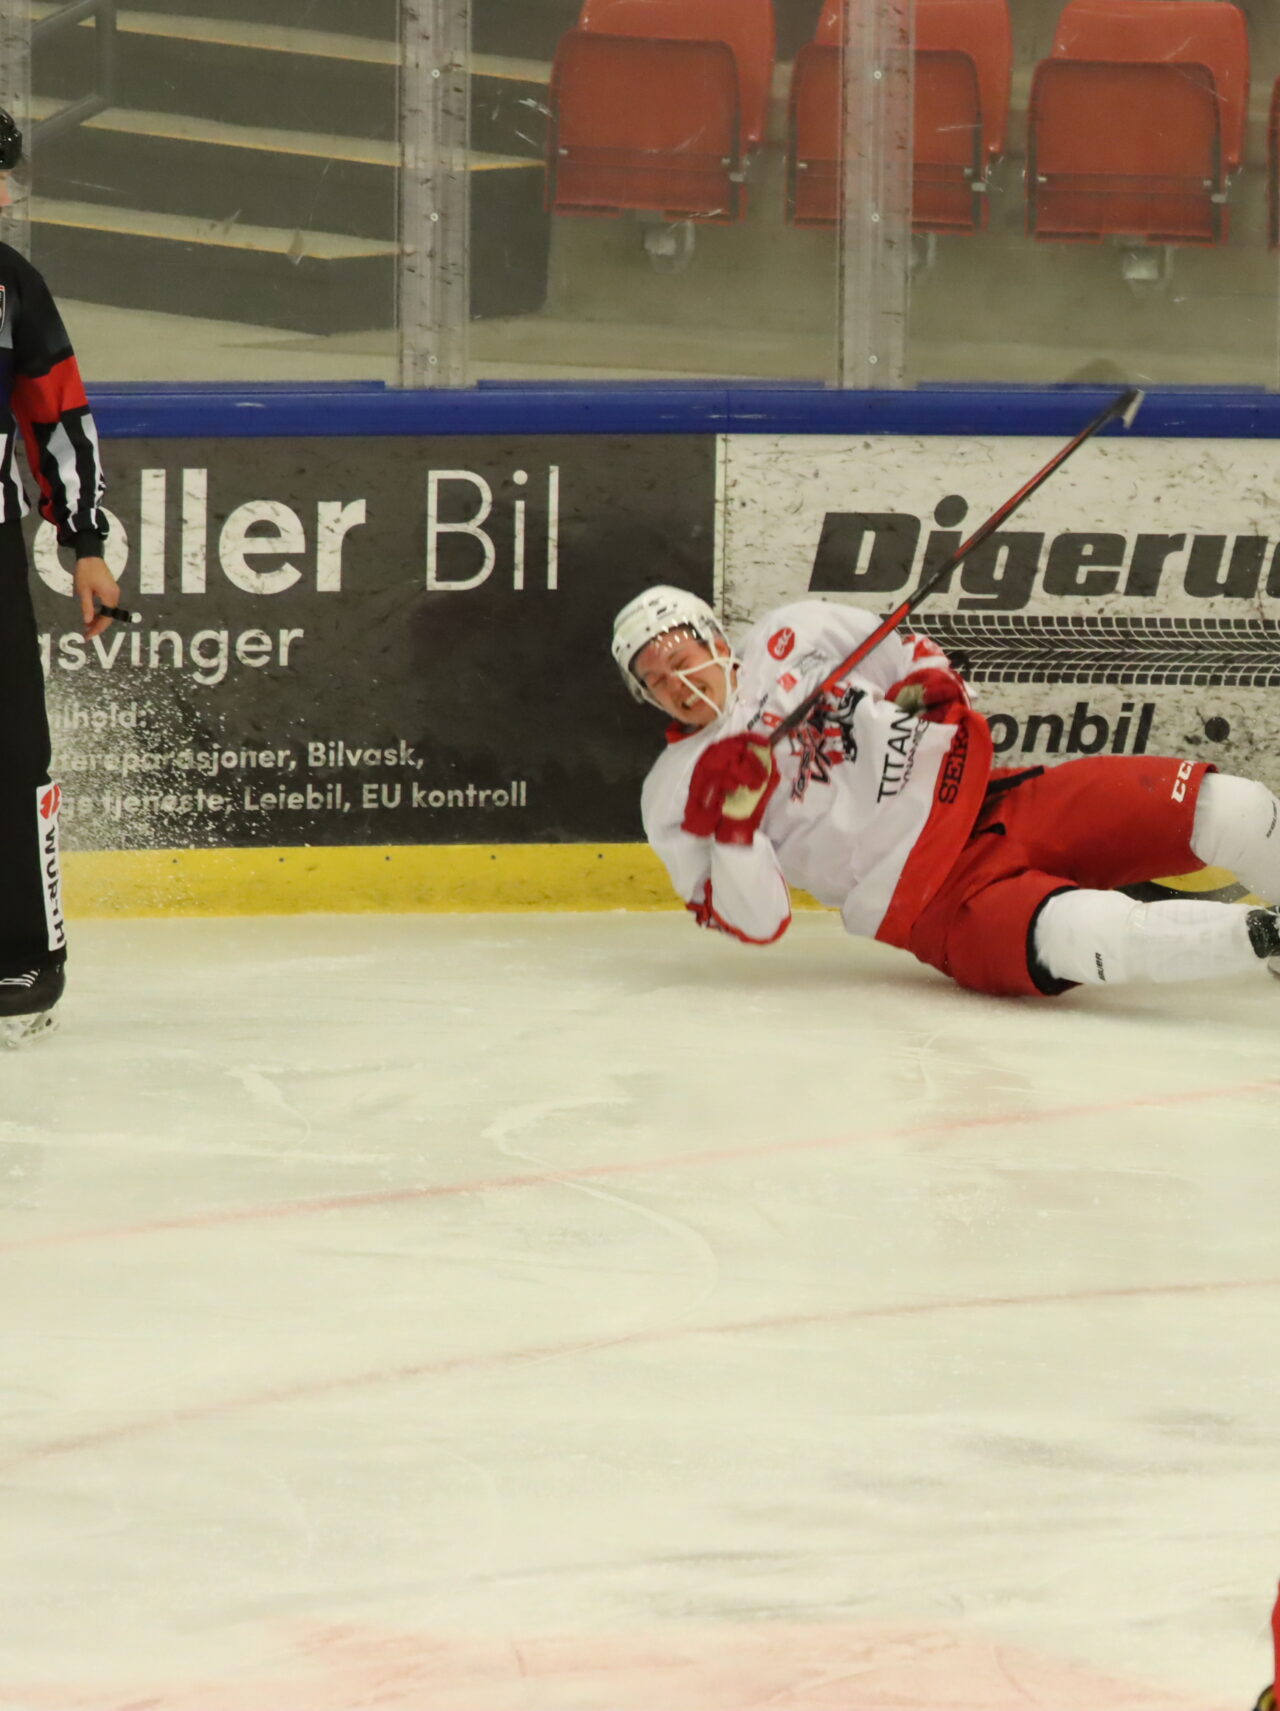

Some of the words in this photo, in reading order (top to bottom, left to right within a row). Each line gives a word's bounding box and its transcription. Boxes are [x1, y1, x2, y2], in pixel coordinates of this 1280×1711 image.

[426, 466, 559, 592] Bil
[307, 740, 424, 769] Bilvask,
[244, 783, 351, 813] Leiebil,
[362, 783, 401, 809] EU
[412, 781, 527, 808] kontroll
